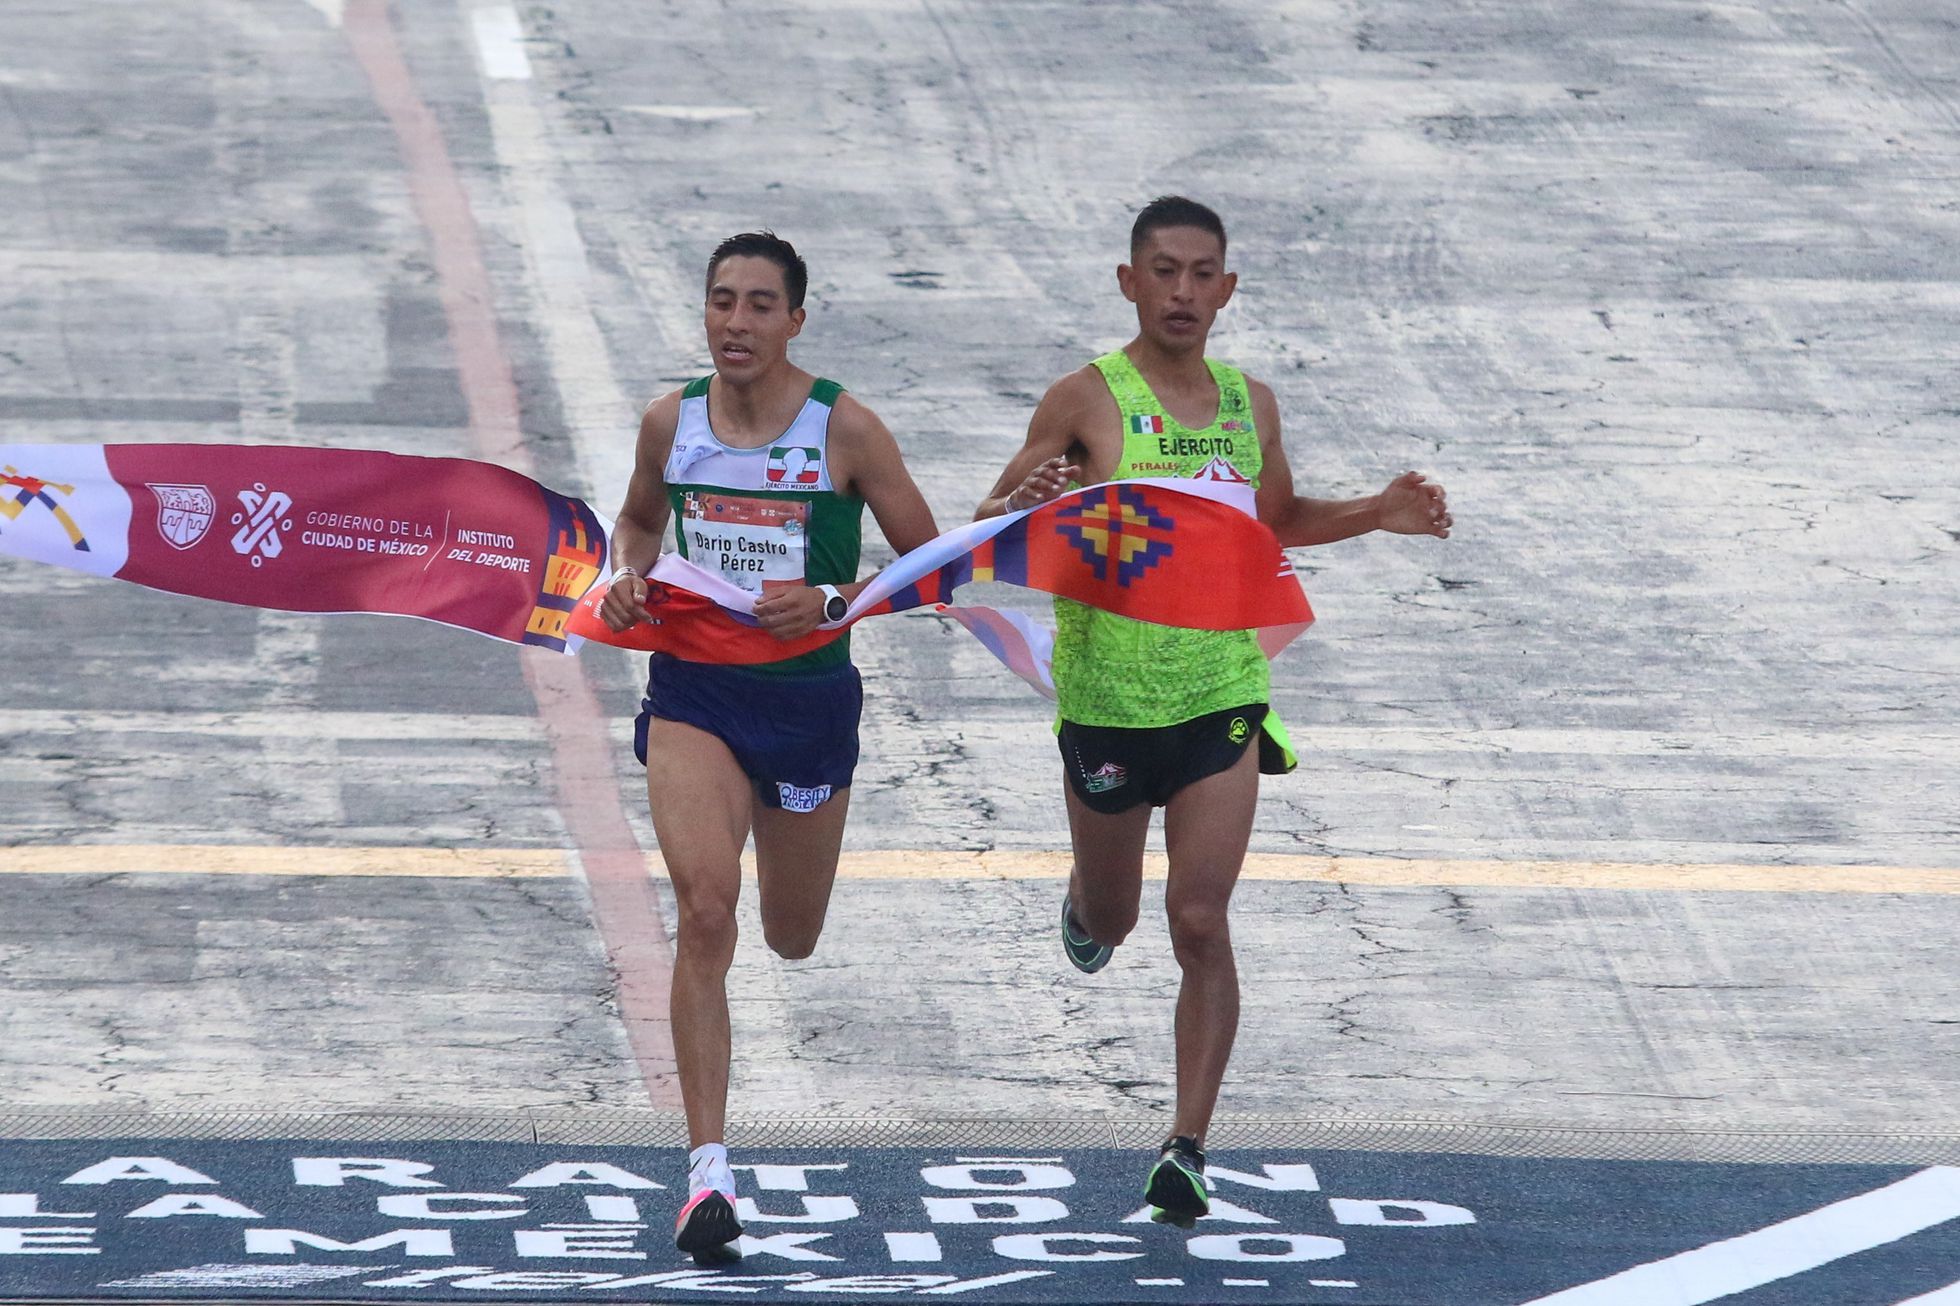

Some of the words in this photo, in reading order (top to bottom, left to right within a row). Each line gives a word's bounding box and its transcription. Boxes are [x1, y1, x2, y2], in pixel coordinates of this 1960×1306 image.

[1158, 437, 1233, 456] EJERCITO
[790, 483, 819, 491] MEXICANO
[306, 511, 384, 533] GOBIERNO
[389, 520, 410, 536] DE
[415, 523, 433, 539] LA
[301, 531, 354, 549] CIUDAD
[357, 537, 376, 552] DE
[378, 538, 429, 556] MÉXICO
[457, 528, 514, 550] INSTITUTO
[695, 531, 732, 551] Dario
[738, 536, 787, 555] Castro
[447, 548, 474, 562] DEL
[475, 552, 531, 573] DEPORTE
[720, 553, 765, 572] Pérez
[781, 786, 829, 802] OBESITY
[60, 1155, 1320, 1191] ARATÓN
[0, 1226, 102, 1255] E
